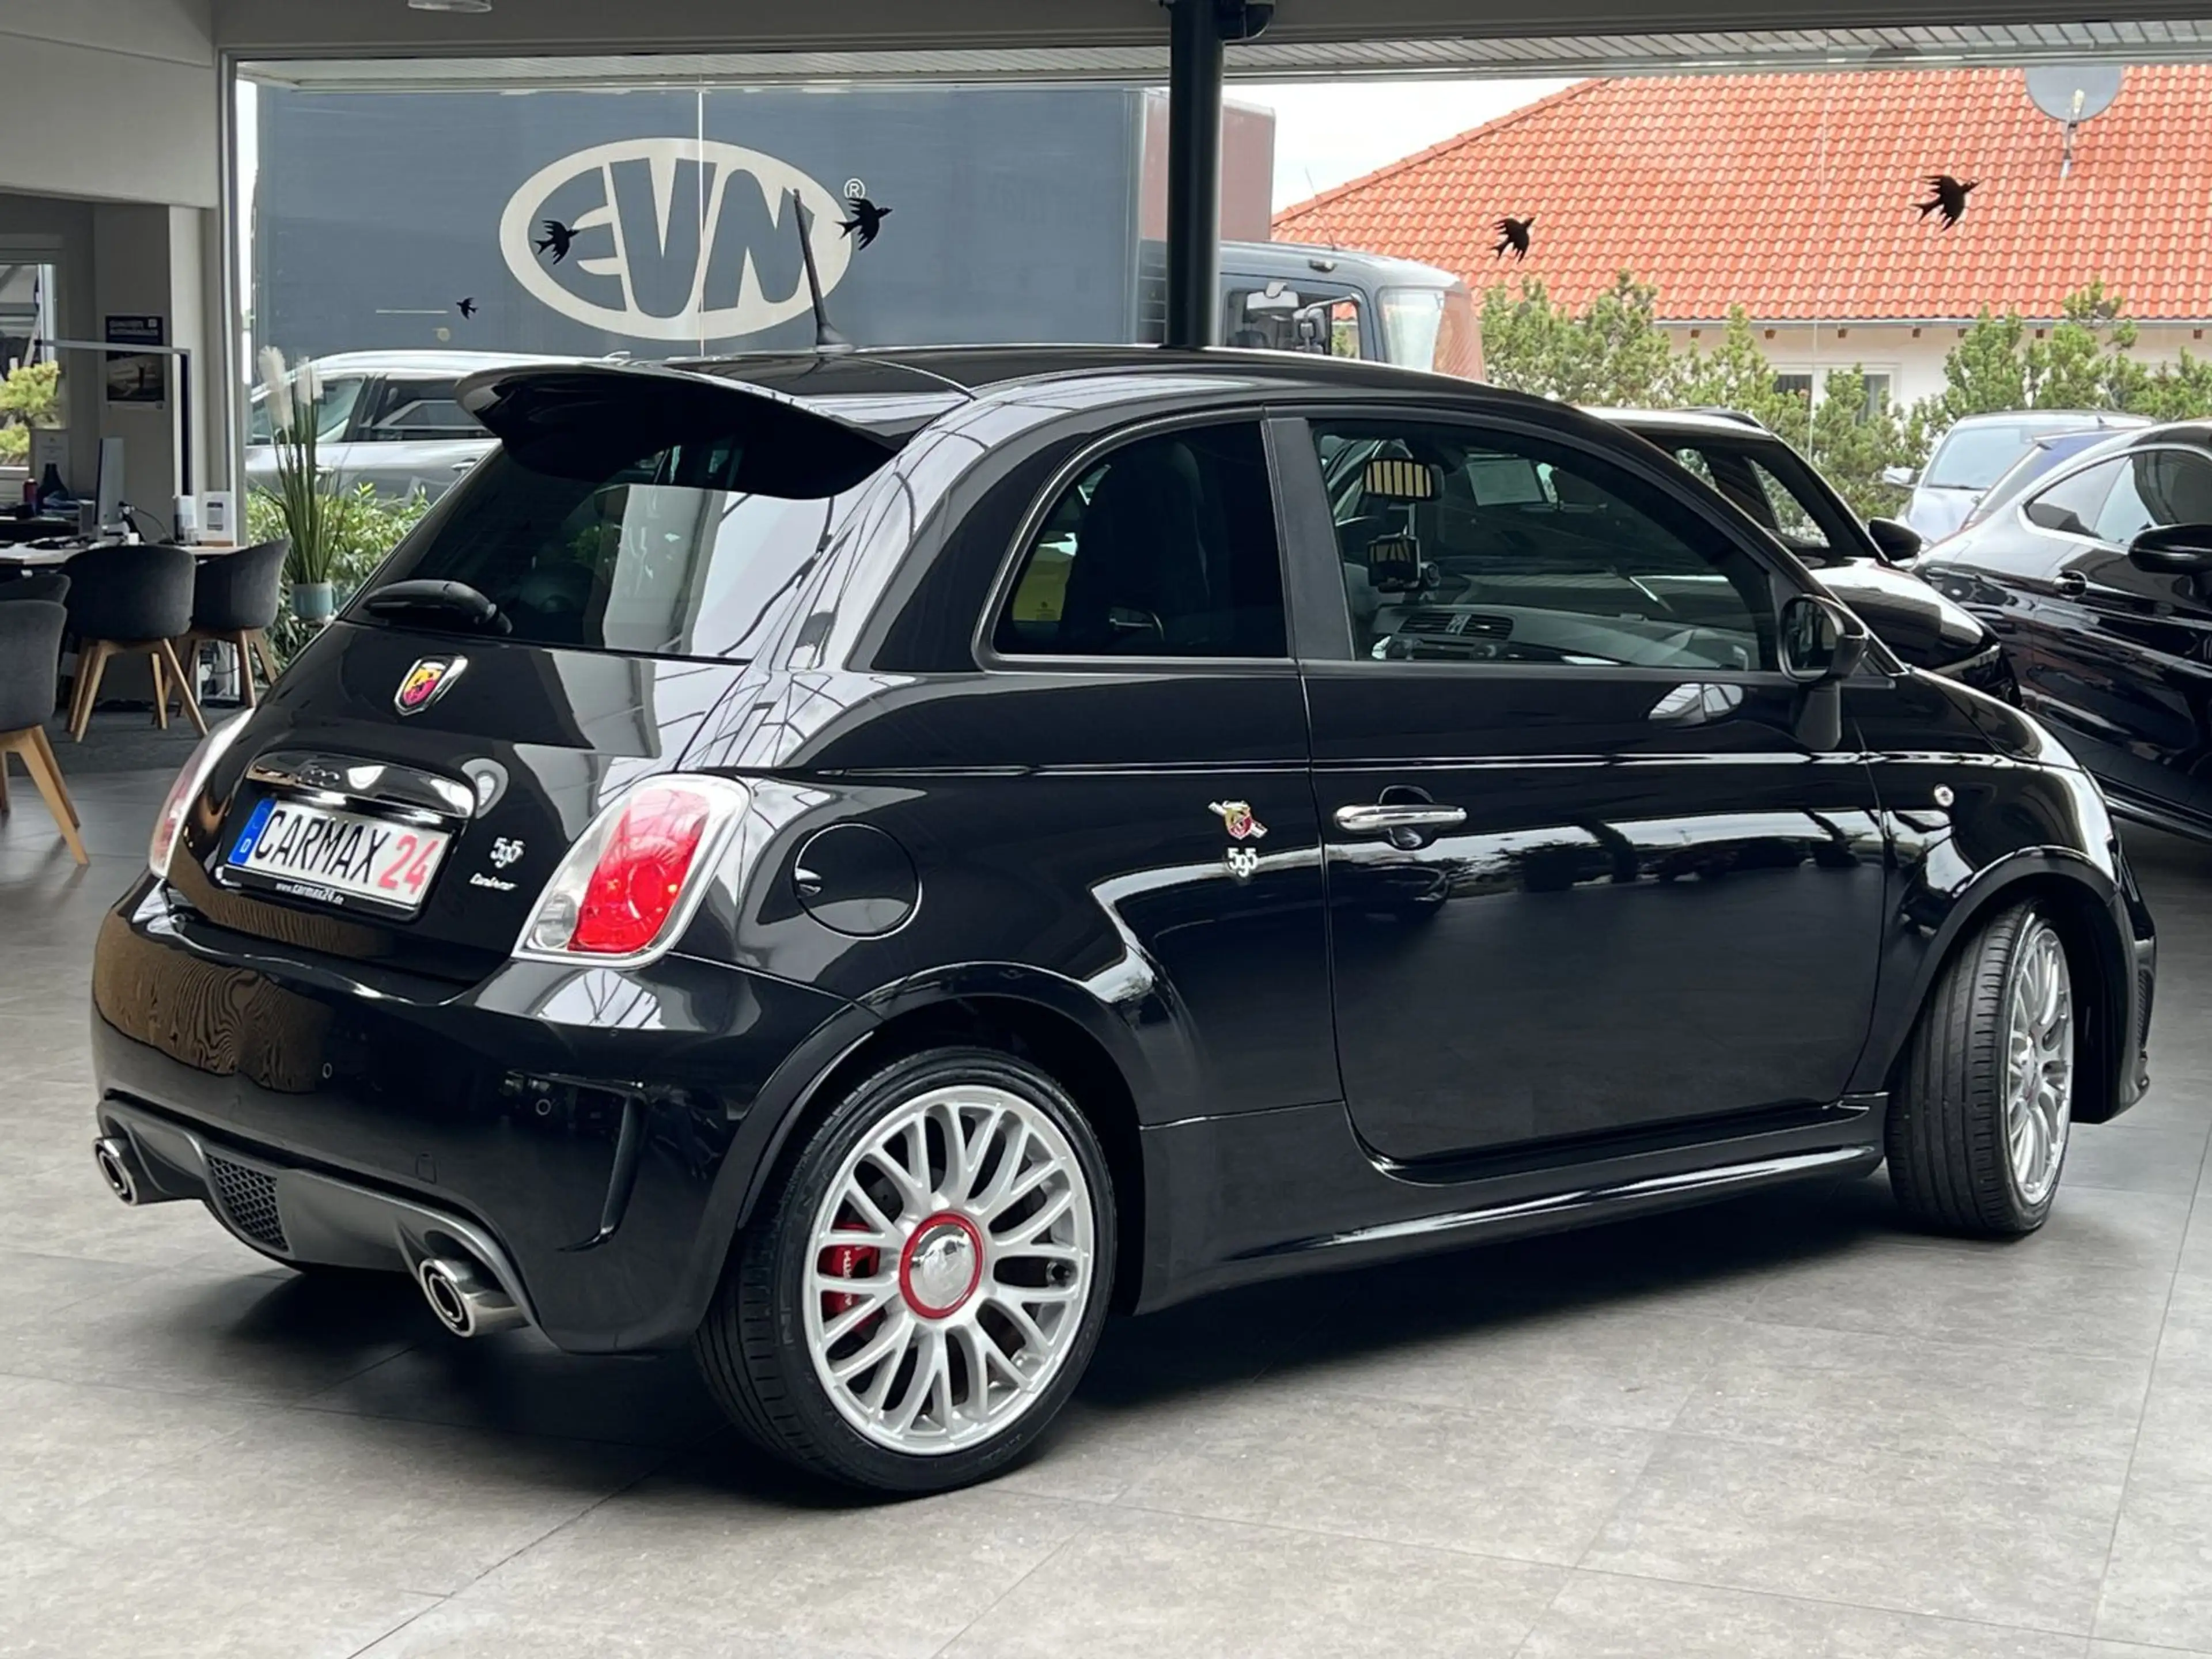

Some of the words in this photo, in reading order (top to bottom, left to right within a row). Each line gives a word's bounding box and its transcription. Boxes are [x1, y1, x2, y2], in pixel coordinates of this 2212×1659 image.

[254, 809, 392, 885] CARMAX
[378, 834, 440, 895] 24
[1227, 847, 1258, 878] 595
